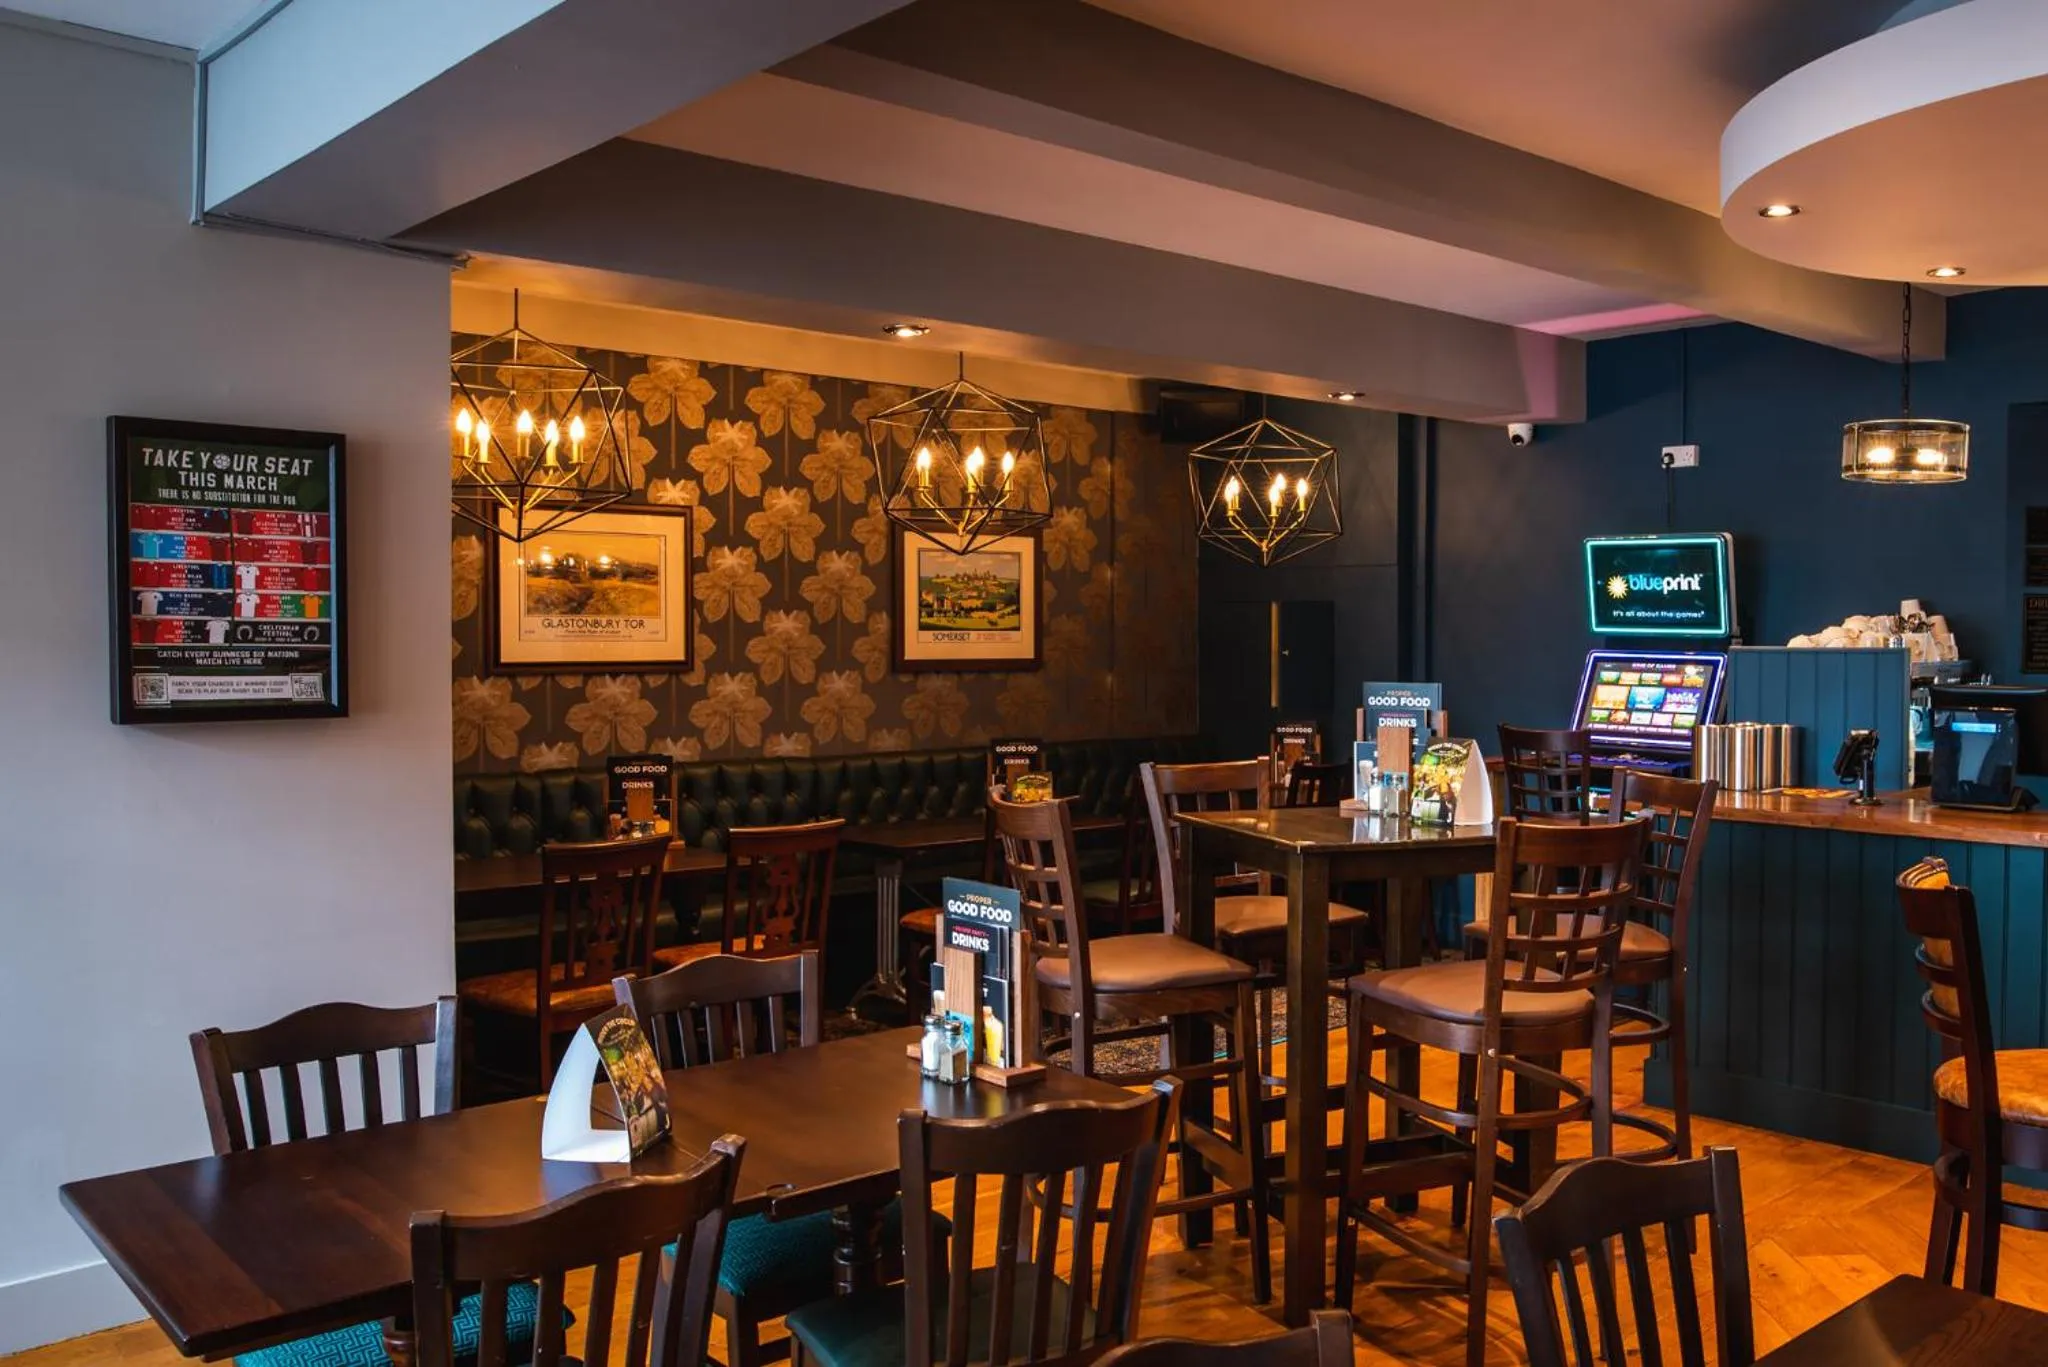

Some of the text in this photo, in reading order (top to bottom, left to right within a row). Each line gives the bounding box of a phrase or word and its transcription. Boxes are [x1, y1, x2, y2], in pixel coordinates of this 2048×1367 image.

[142, 448, 194, 468] TAKE
[264, 456, 314, 477] SEAT
[178, 471, 278, 491] THIS MARCH
[182, 489, 189, 499] IS
[1629, 574, 1702, 595] blueprint
[542, 618, 646, 630] GLASTONBURY TOR
[932, 632, 971, 642] SOMERSET
[1368, 696, 1431, 707] GOOD FOOD
[1378, 717, 1417, 728] DRINKS
[614, 765, 668, 774] GOOD FOOD
[622, 781, 655, 789] DRINKS
[966, 893, 993, 905] PROPER
[948, 899, 1013, 923] GOOD FOOD
[952, 932, 990, 952] DRINKS
